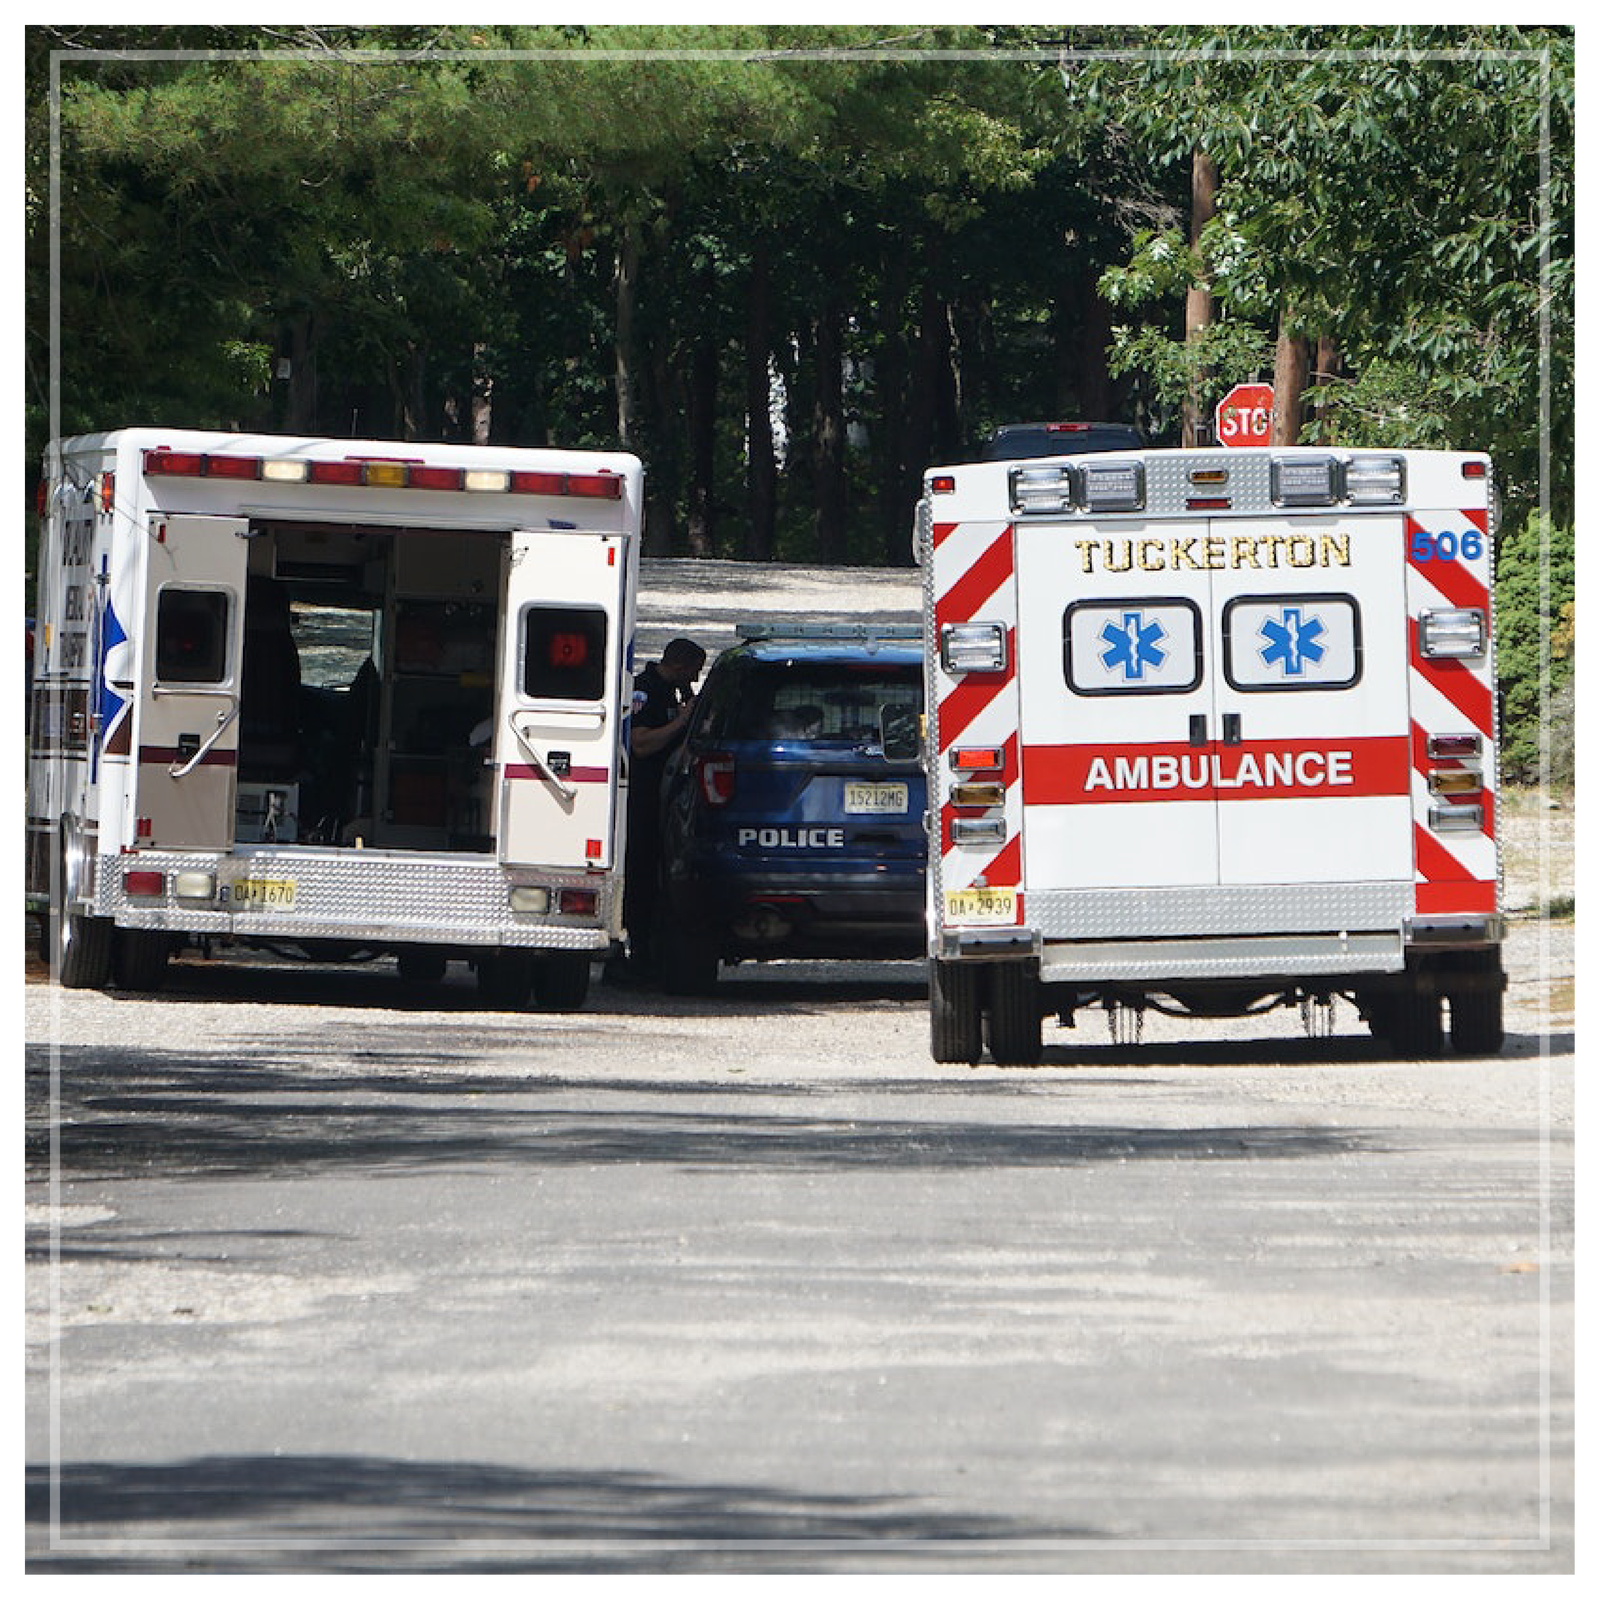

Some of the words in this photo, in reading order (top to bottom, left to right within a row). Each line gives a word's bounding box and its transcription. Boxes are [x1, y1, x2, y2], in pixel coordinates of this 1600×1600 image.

[1223, 408, 1274, 436] STO
[1074, 532, 1352, 574] TUCKERTON
[1411, 530, 1483, 562] 506
[1083, 750, 1355, 792] AMBULANCE
[849, 789, 903, 807] 15212MG
[738, 828, 844, 847] POLICE
